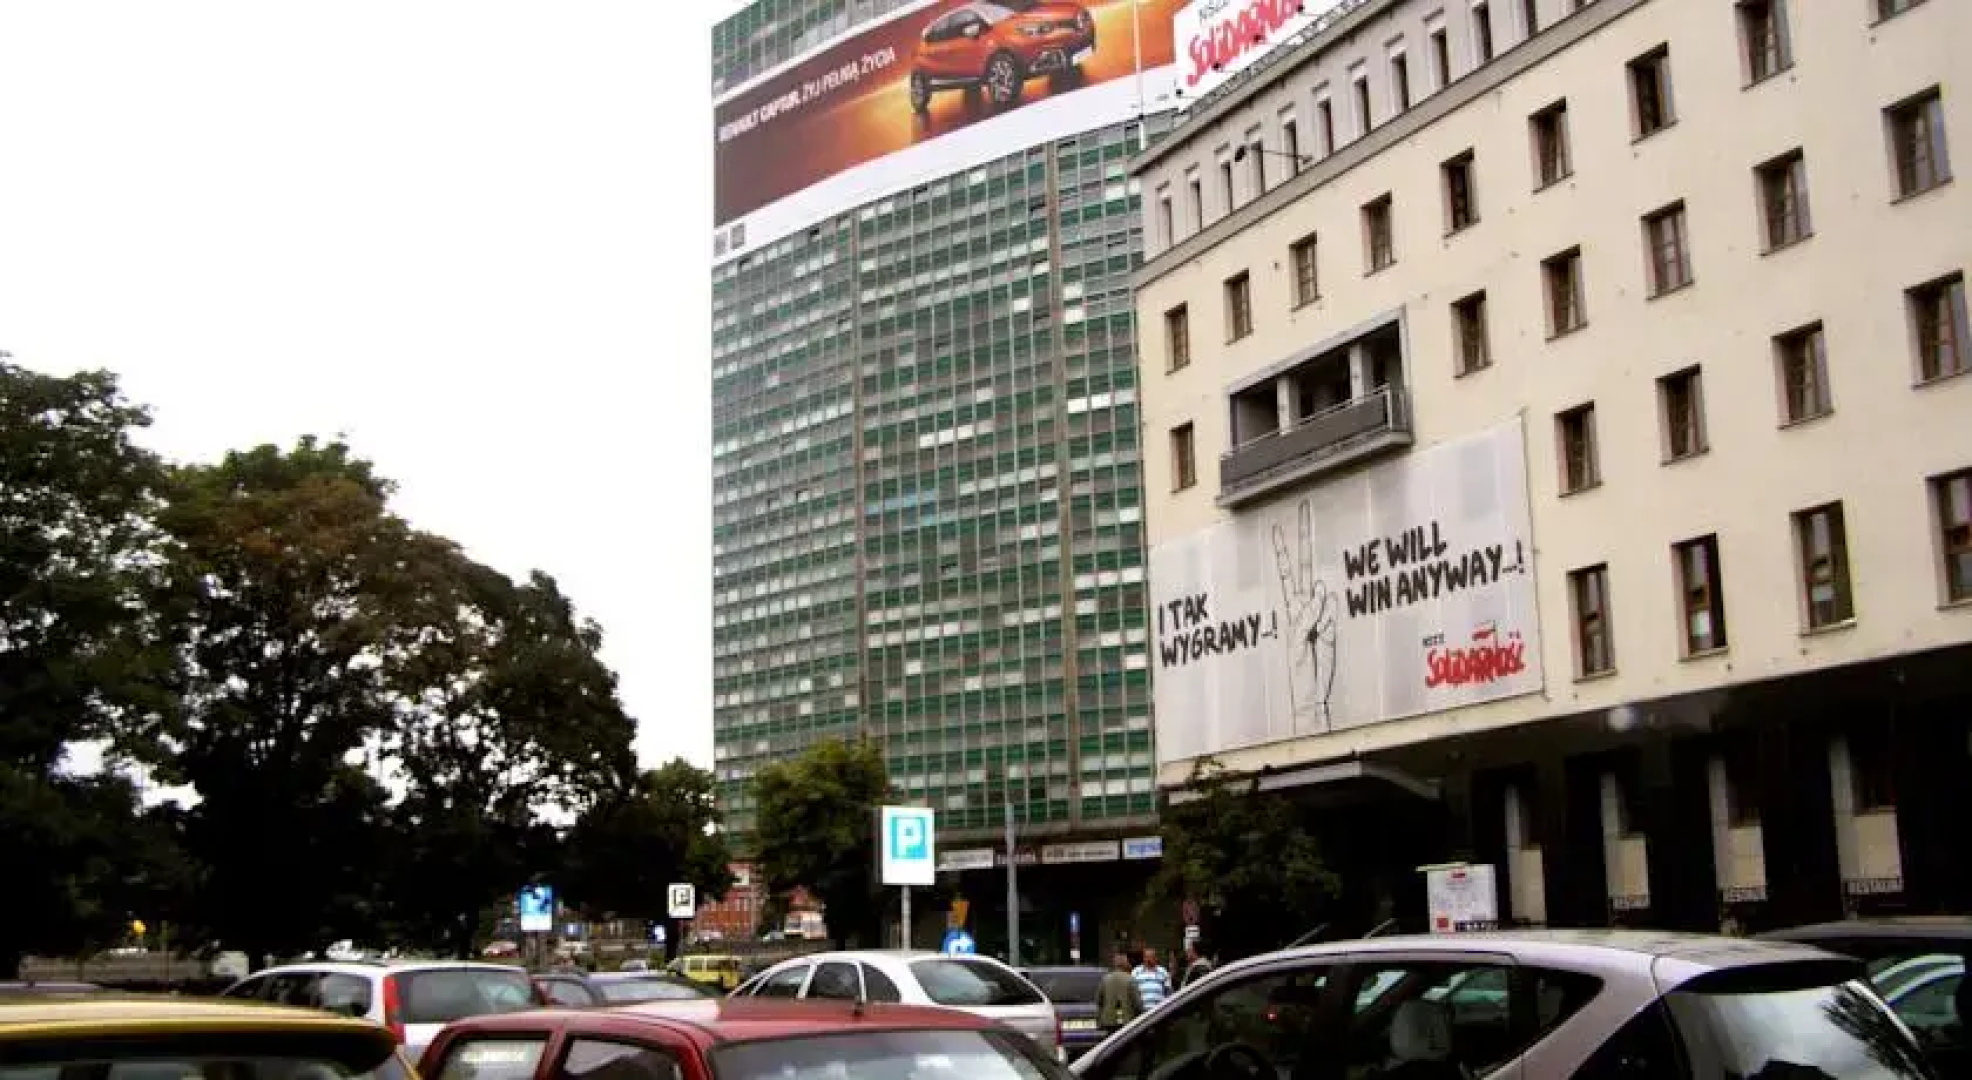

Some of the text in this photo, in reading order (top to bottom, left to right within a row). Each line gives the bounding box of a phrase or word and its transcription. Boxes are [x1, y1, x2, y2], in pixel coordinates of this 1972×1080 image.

[1343, 520, 1447, 580] WE WILL
[1158, 592, 1208, 636] I TAK
[1345, 575, 1392, 618] WIN
[897, 818, 921, 857] P
